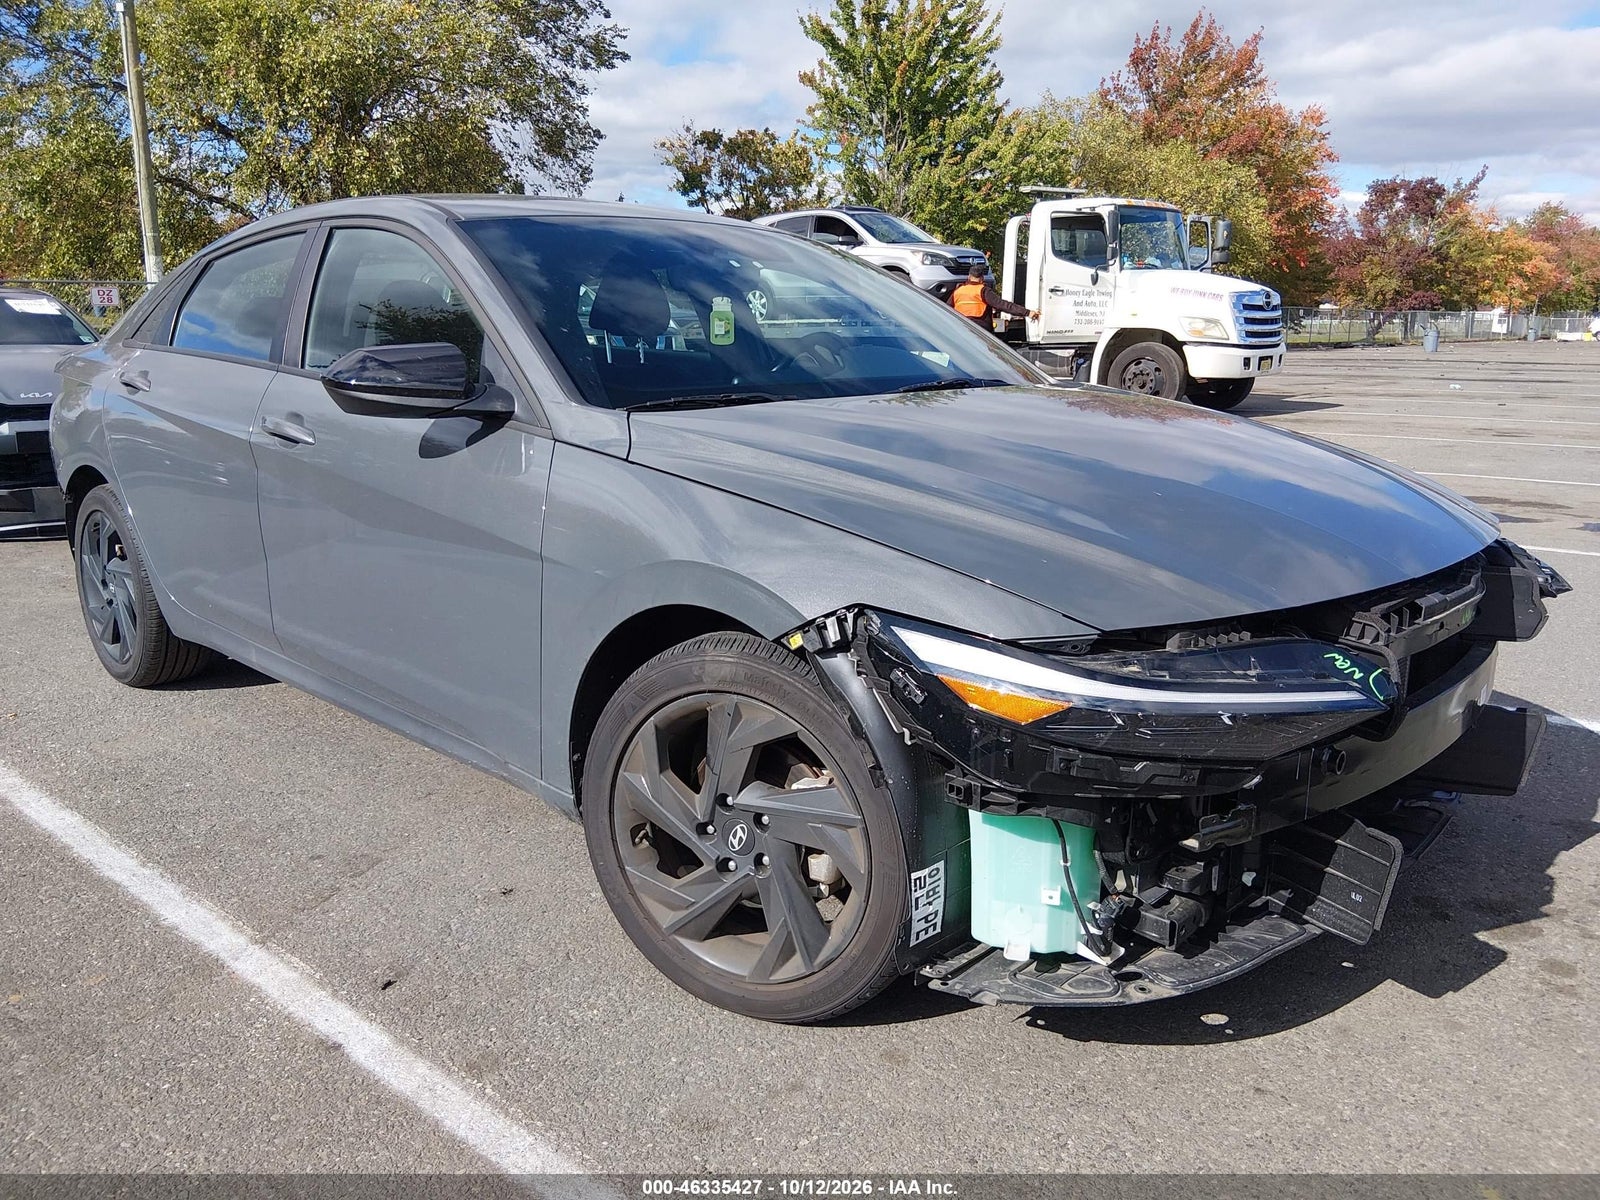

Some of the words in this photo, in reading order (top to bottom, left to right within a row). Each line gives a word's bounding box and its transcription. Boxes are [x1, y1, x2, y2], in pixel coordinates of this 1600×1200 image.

[97, 289, 113, 297] DZ
[1082, 289, 1095, 298] Eagle
[1096, 290, 1112, 299] Towing
[99, 296, 113, 304] 28
[915, 909, 939, 942] PE
